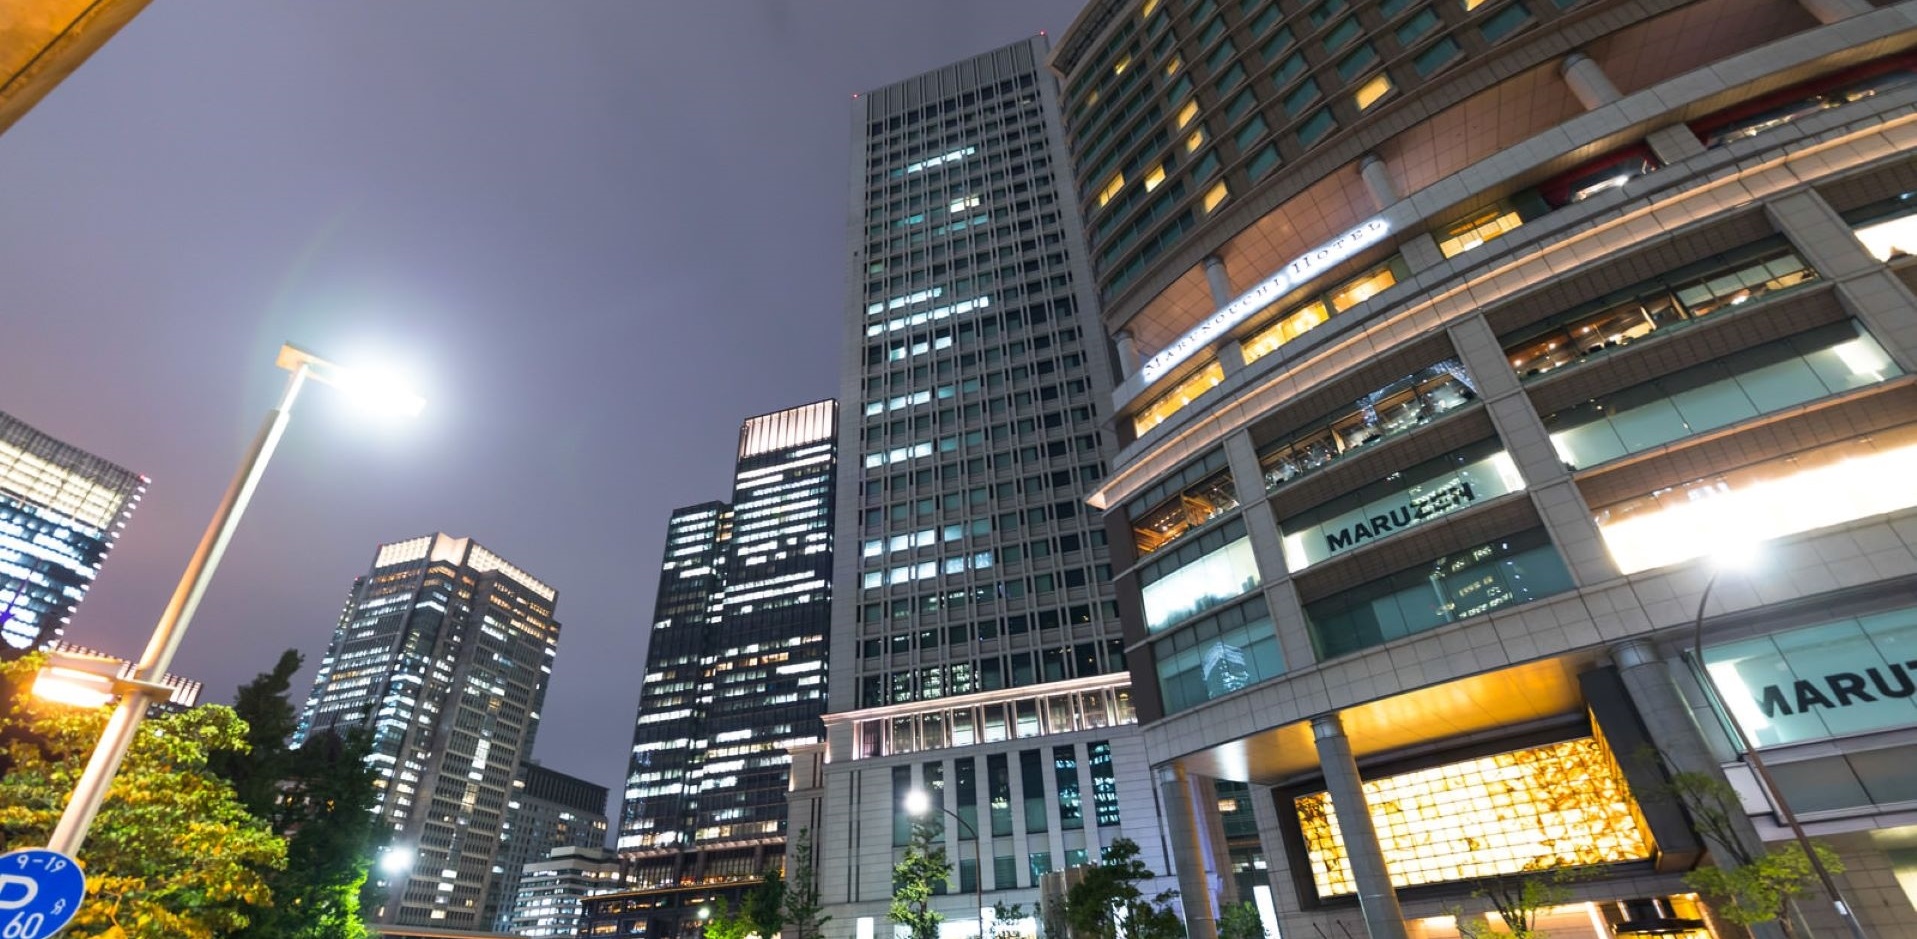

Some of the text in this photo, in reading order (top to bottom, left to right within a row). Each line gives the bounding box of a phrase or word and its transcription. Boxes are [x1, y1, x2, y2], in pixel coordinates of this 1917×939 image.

[1292, 219, 1382, 275] HOTEL
[17, 854, 67, 872] 9-19
[0, 873, 38, 910] P
